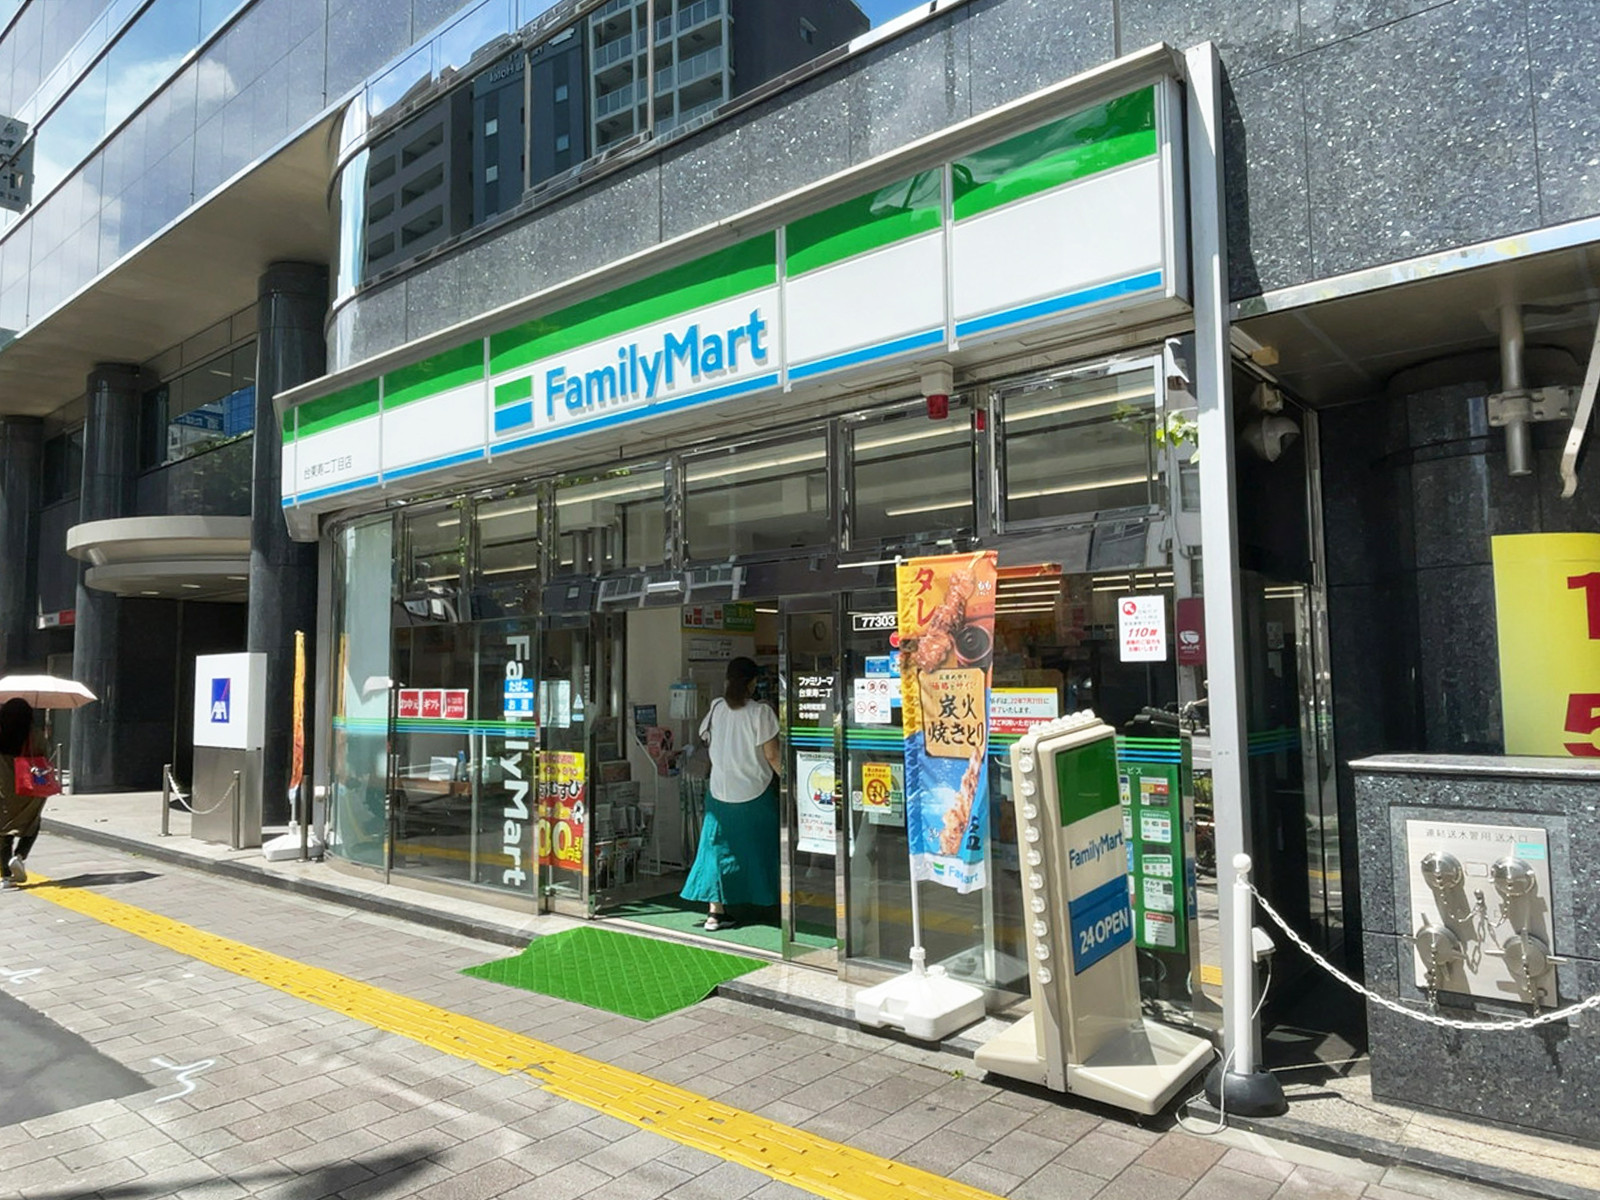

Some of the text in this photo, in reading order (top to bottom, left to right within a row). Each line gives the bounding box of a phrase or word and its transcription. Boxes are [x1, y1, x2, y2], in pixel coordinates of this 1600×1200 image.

[546, 308, 768, 418] FamilyMart
[911, 567, 935, 627] タレ
[861, 615, 896, 628] 77303
[938, 693, 977, 720] 炭火
[927, 720, 984, 748] 焼きとり
[1069, 828, 1124, 870] FamilyMart
